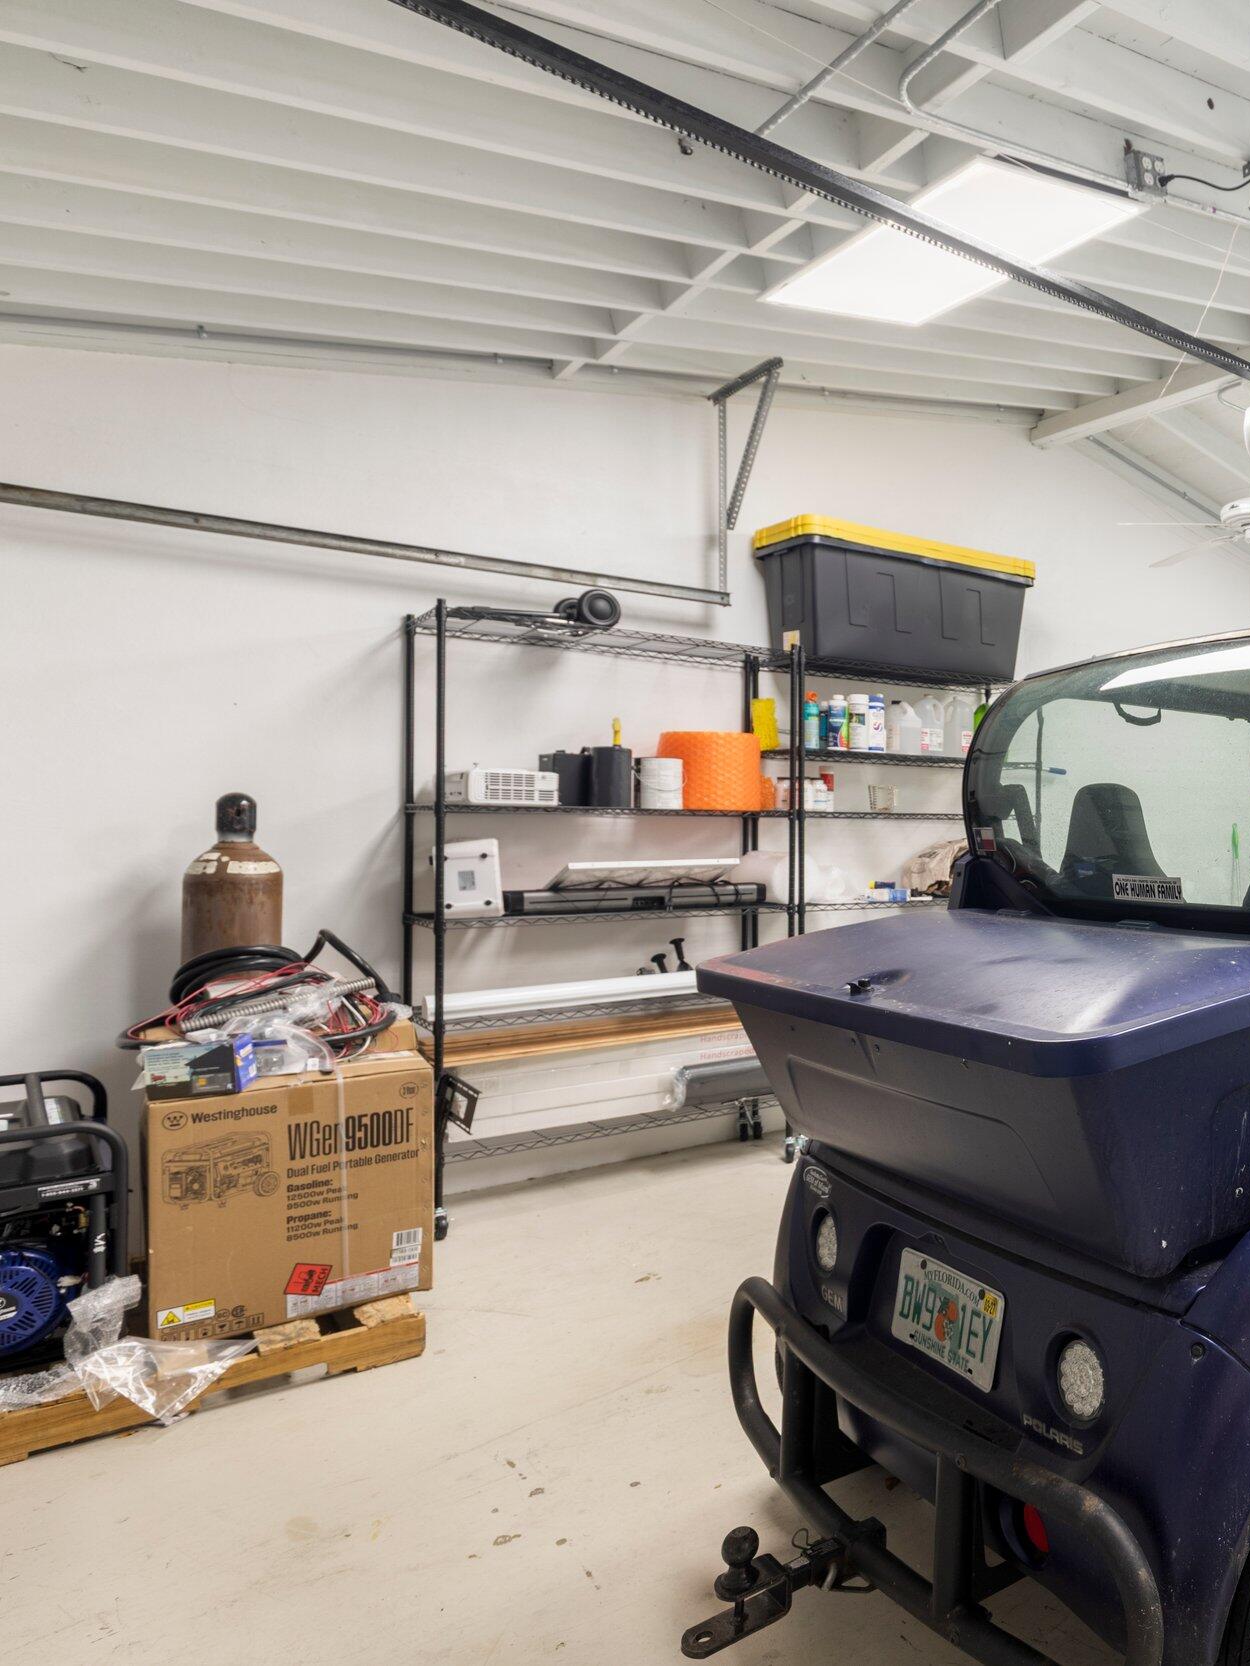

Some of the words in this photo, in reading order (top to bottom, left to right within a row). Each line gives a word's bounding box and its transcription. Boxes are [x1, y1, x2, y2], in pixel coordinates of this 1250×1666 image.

[1115, 882, 1129, 896] ONE
[1131, 883, 1155, 898] HUMAN
[1158, 885, 1181, 900] FAMILY
[190, 1104, 278, 1124] Westinghouse
[286, 1165, 309, 1179] Dual
[310, 1160, 331, 1175] Fuel
[374, 1148, 420, 1165] Generator
[286, 1178, 334, 1193] Gasoline:
[325, 1185, 346, 1195] Pea
[286, 1198, 321, 1211] 9500w
[322, 1192, 359, 1207] Runng
[286, 1209, 332, 1225] Propane:
[322, 1222, 359, 1236] Runng
[912, 1329, 946, 1359] SUNSHINE
[947, 1350, 970, 1373] STATE
[1022, 1412, 1084, 1456] POLARIS
